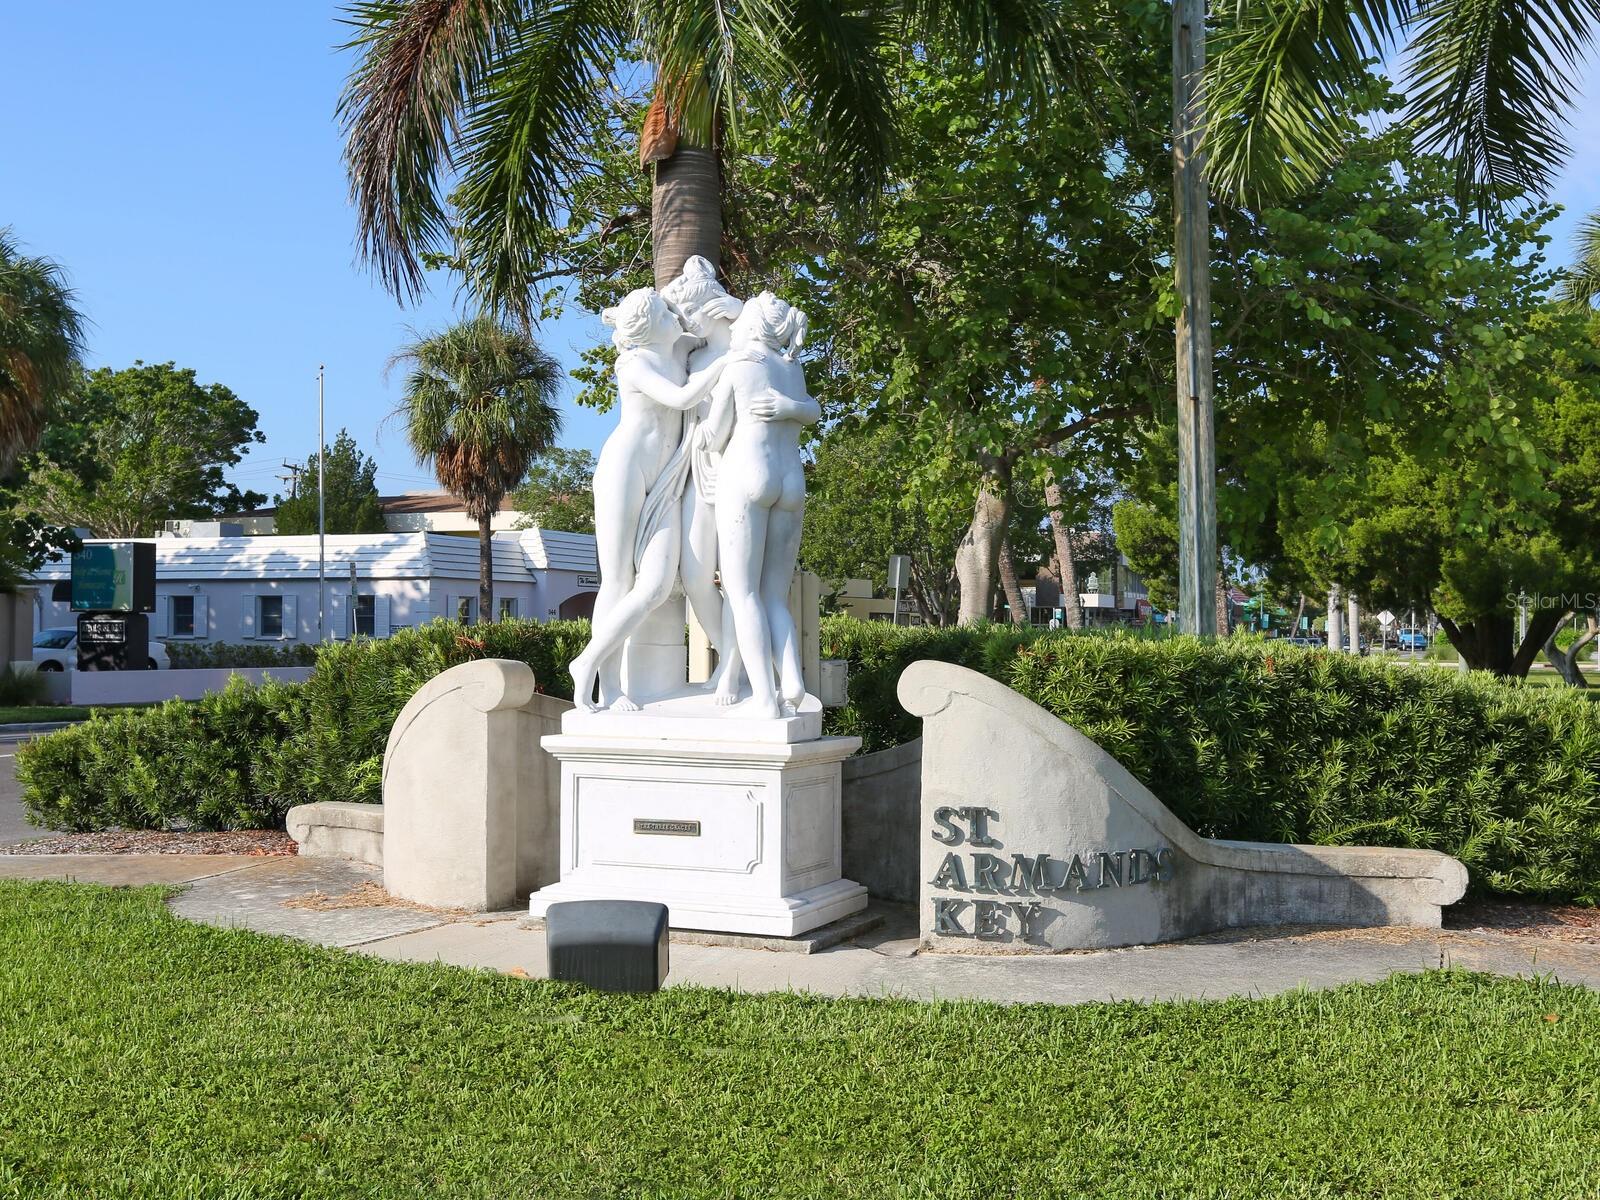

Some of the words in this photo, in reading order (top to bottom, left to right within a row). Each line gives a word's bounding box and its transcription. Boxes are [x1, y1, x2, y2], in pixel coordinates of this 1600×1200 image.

[932, 806, 994, 845] ST.
[928, 848, 1174, 892] ARMANDS
[931, 897, 1042, 939] KEY
